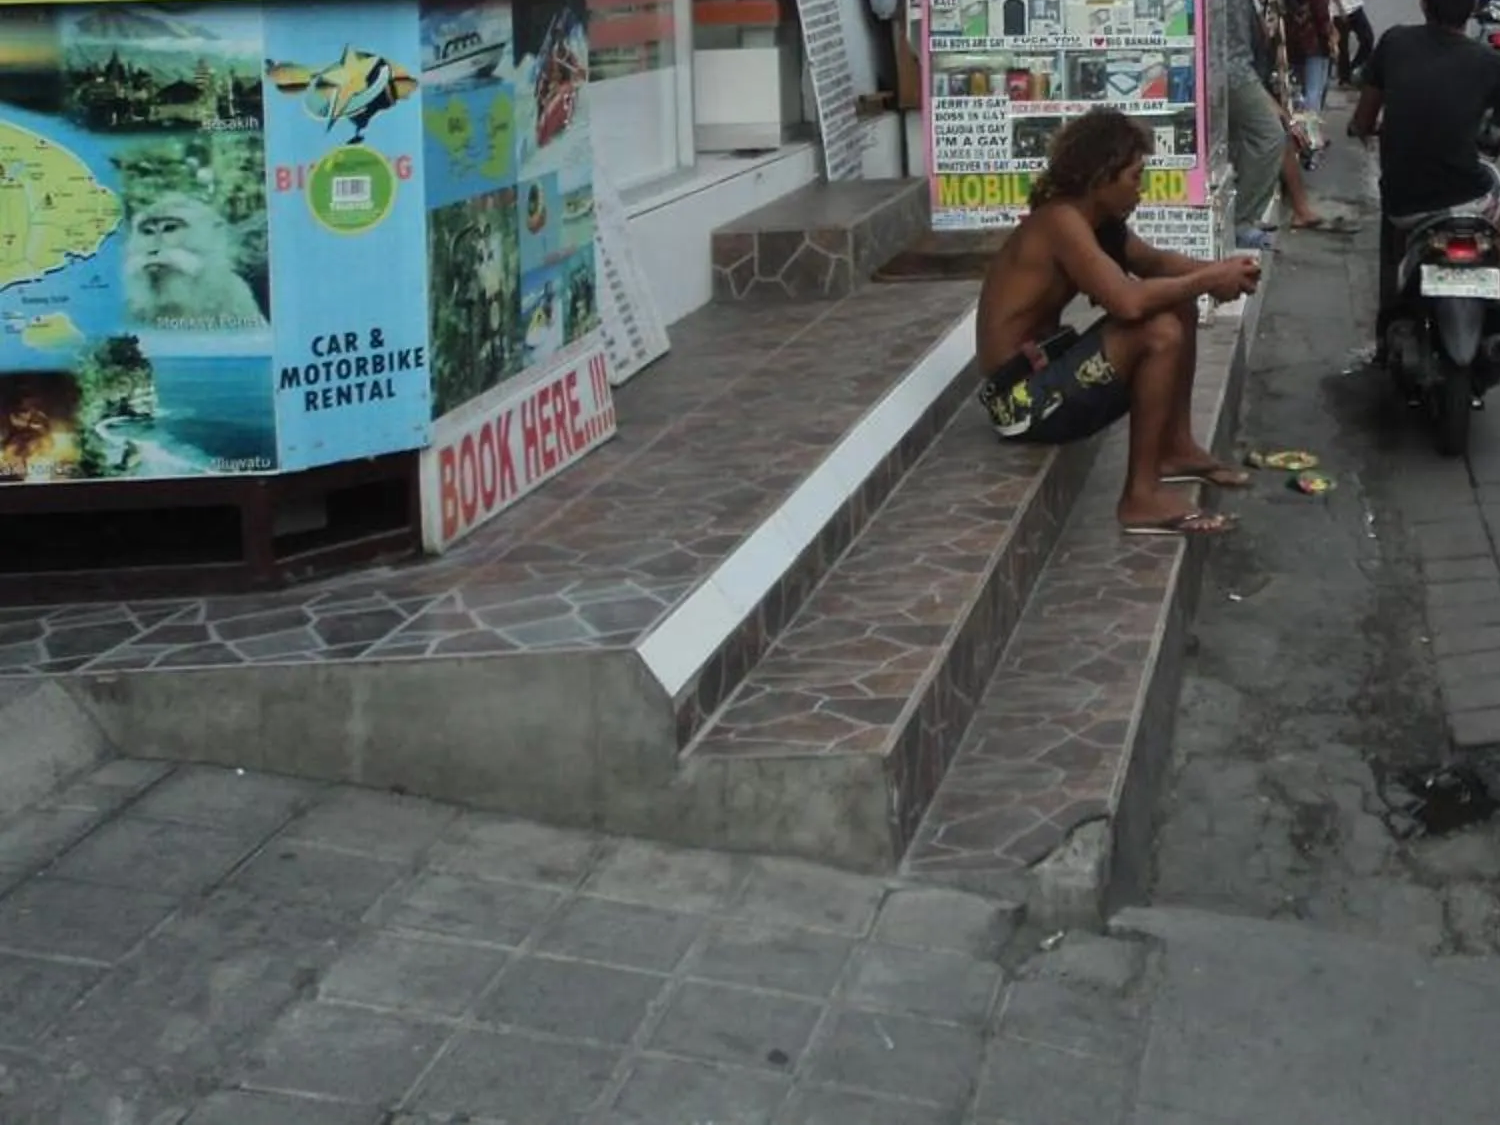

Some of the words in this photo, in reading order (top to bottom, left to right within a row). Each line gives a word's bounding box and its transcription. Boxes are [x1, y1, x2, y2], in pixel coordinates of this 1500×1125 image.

[939, 175, 1030, 207] MOBIL
[312, 332, 357, 357] CAR
[370, 328, 385, 347] &
[279, 346, 425, 390] MOTORBIKE
[304, 379, 397, 412] RENTAL
[438, 408, 518, 540] BOOK
